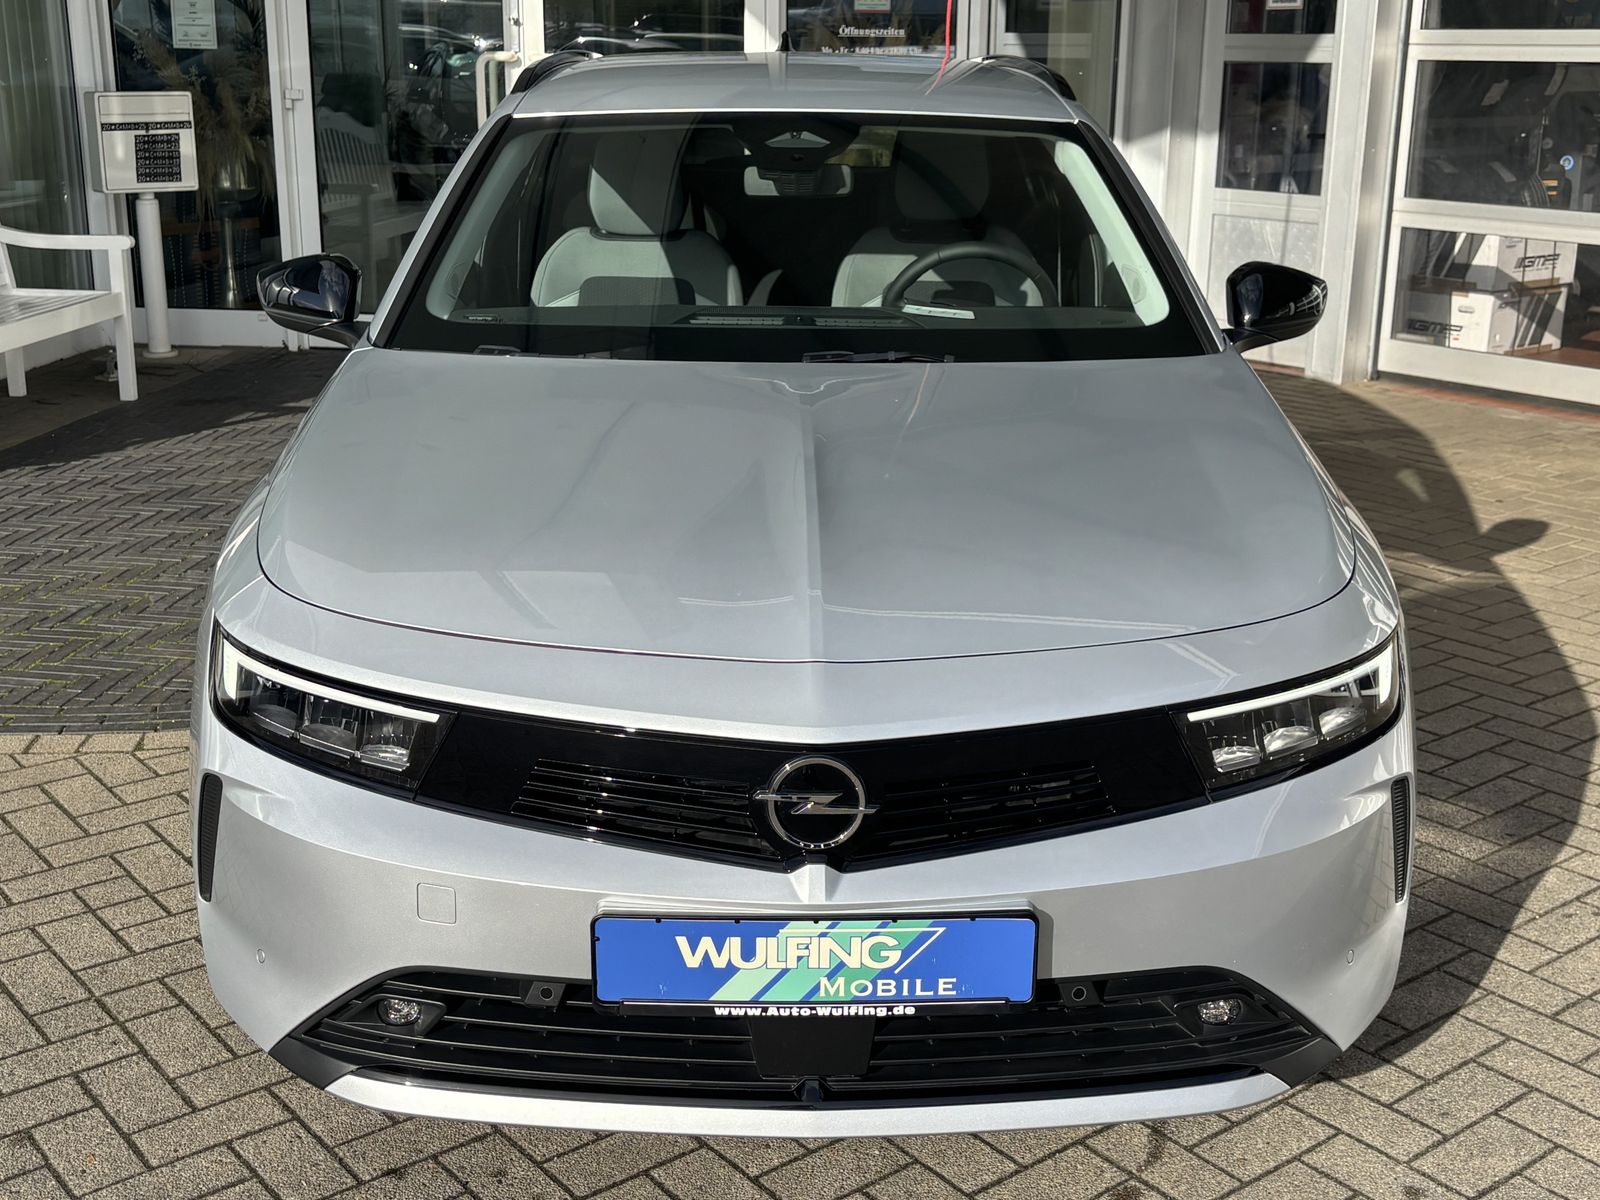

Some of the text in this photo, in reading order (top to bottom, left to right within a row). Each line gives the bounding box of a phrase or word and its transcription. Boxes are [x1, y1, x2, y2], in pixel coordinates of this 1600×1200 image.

[838, 25, 905, 37] Öffnungszeiten
[675, 936, 903, 970] WULFING
[819, 976, 957, 997] MOBILE
[714, 1006, 916, 1017] www.Auto-Wulfing.de
